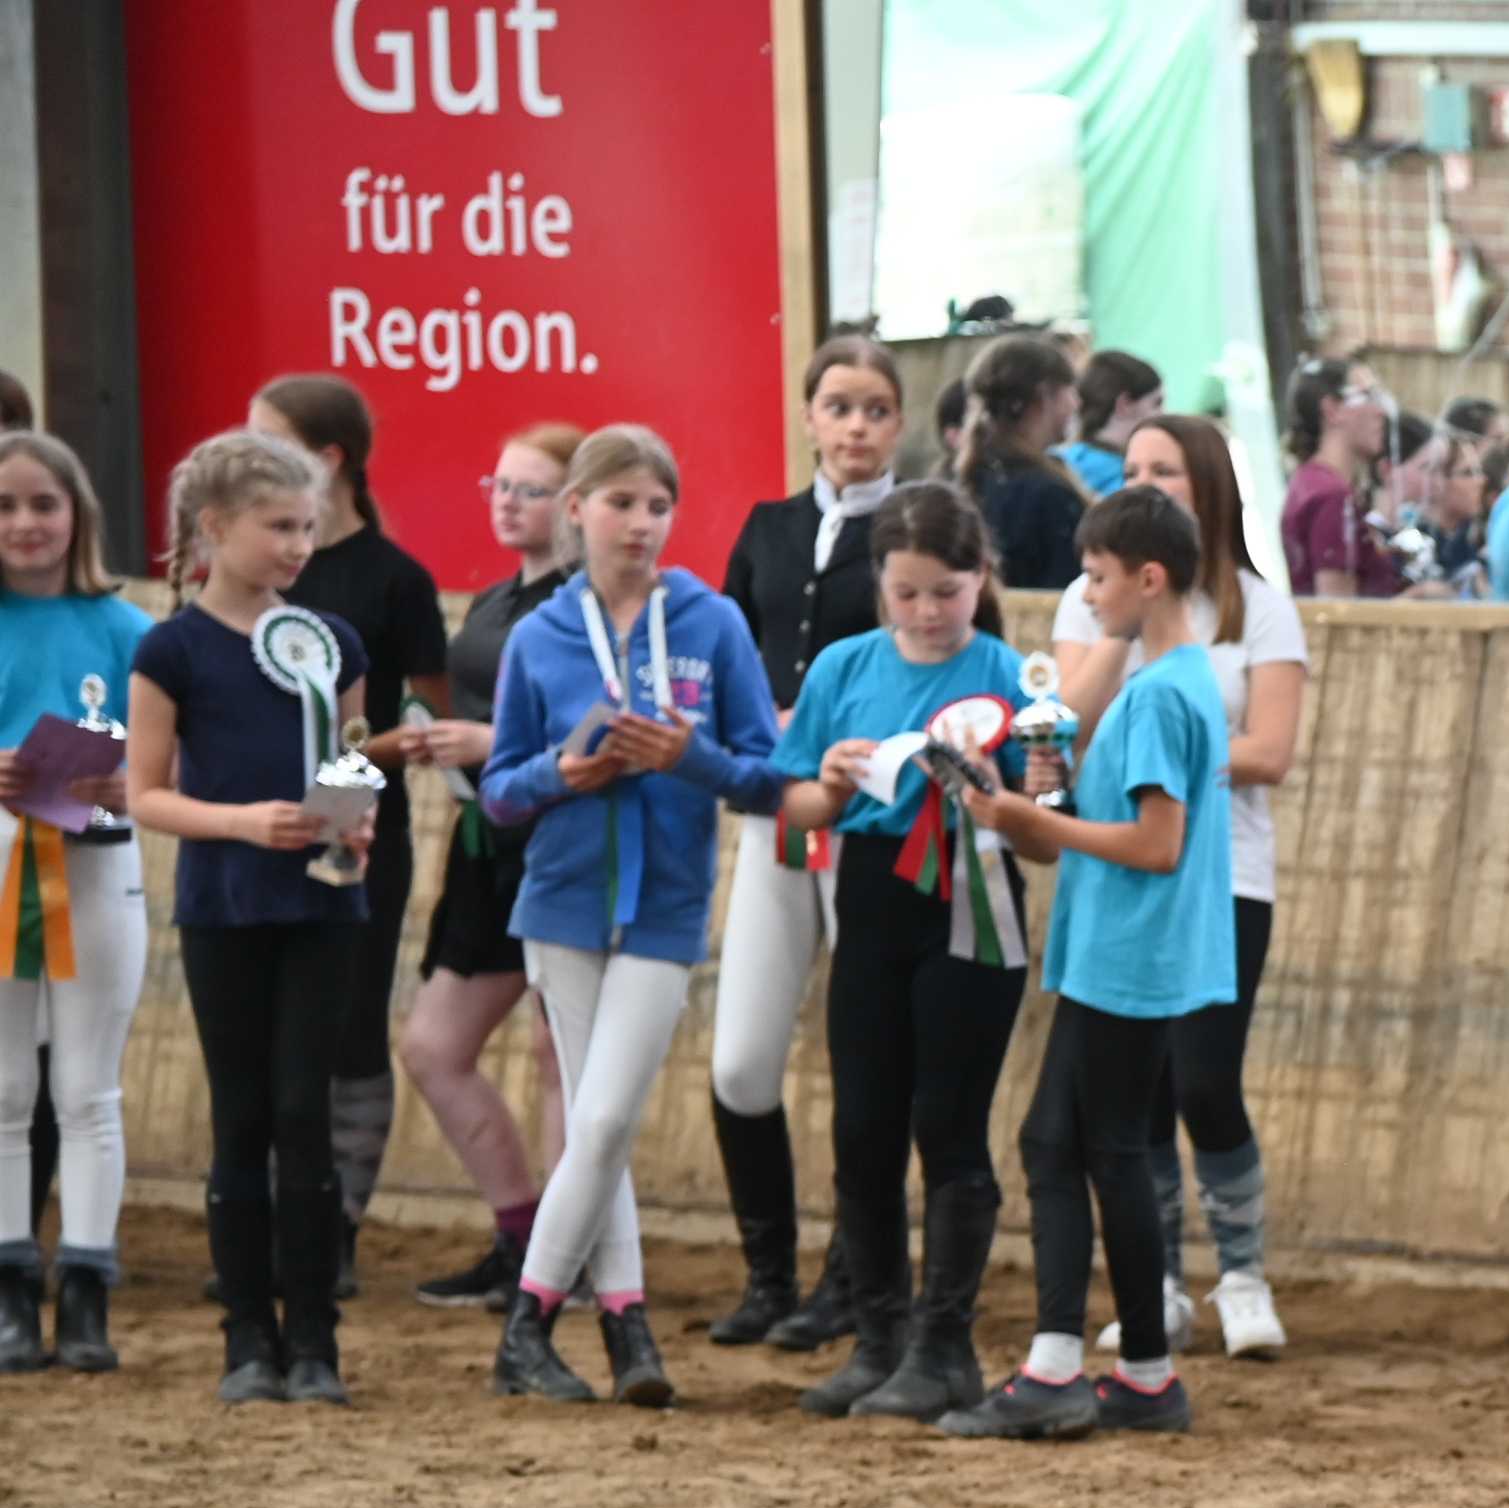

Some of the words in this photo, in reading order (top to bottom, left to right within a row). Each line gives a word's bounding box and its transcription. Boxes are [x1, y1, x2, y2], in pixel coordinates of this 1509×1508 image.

[332, 0, 563, 117] Gut
[343, 168, 444, 255] für
[462, 171, 573, 257] die
[330, 288, 599, 391] Region.
